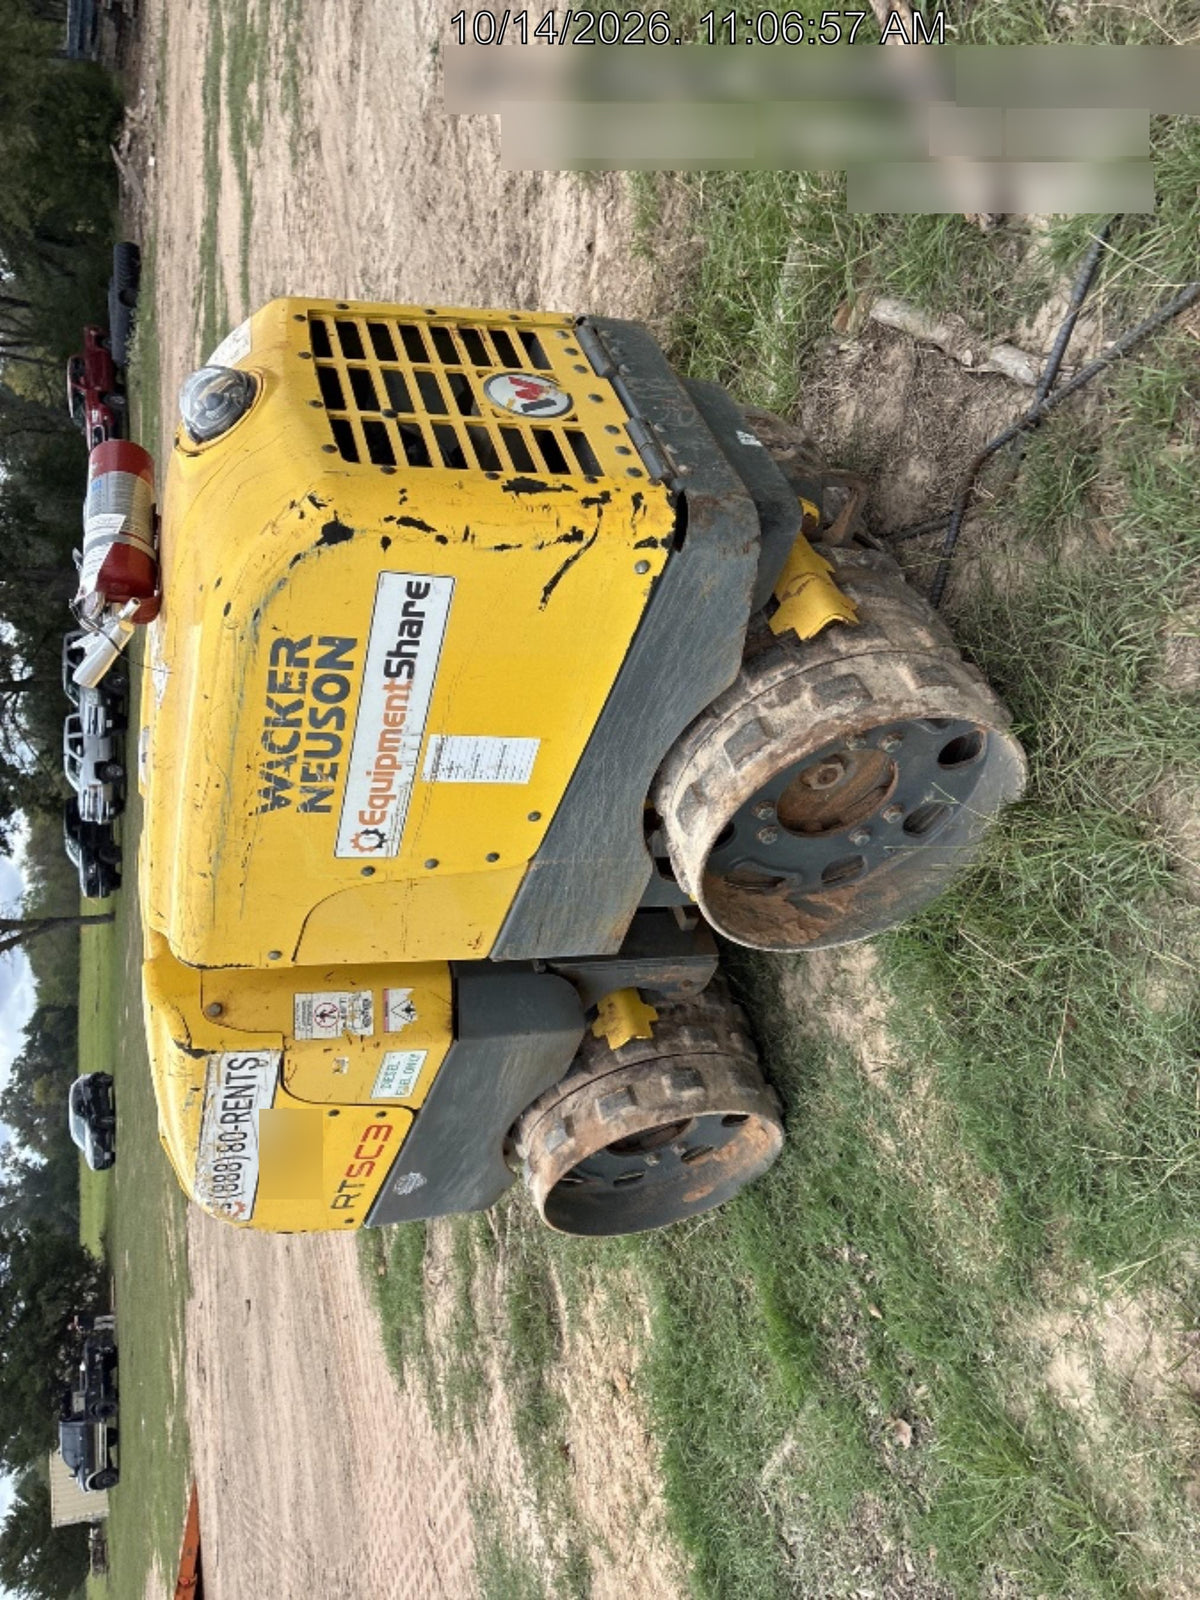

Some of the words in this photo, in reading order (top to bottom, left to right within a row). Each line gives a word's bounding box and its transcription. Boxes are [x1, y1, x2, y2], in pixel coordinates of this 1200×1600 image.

[255, 633, 313, 816] WACKER
[296, 636, 358, 814] NEUSON
[358, 581, 431, 826] EquipmentShare
